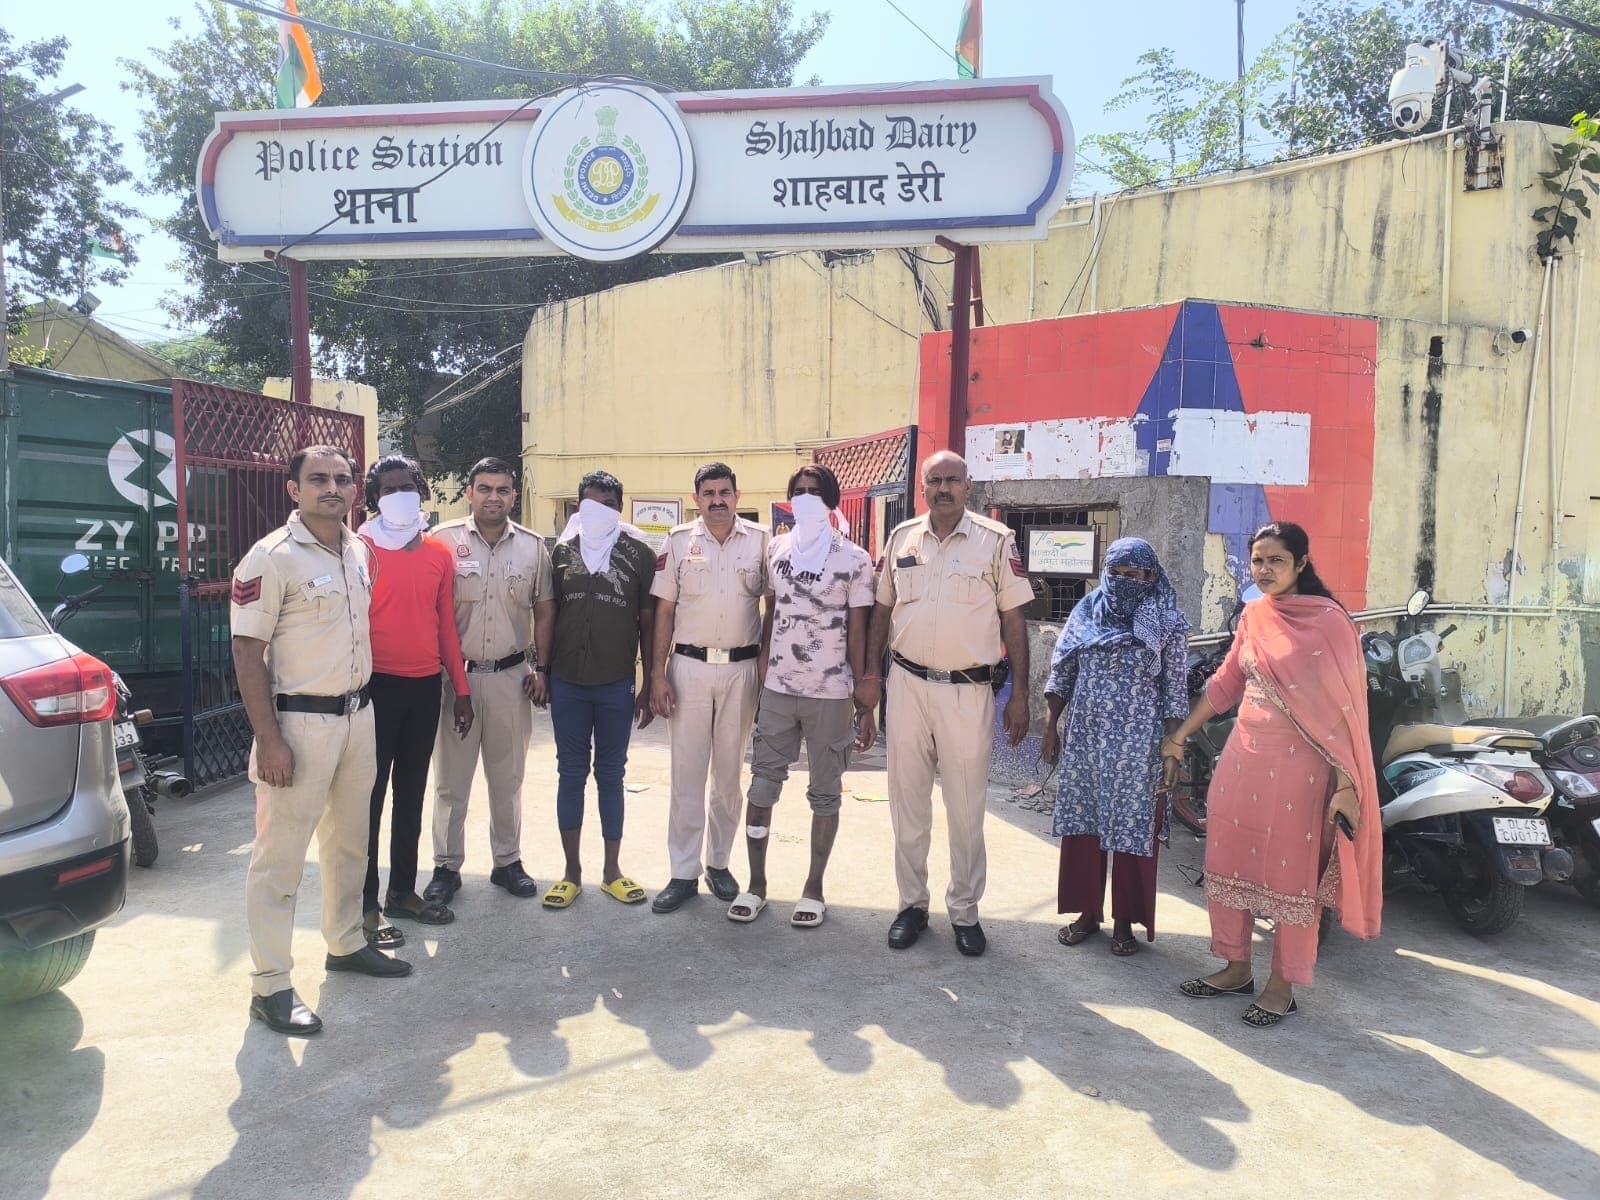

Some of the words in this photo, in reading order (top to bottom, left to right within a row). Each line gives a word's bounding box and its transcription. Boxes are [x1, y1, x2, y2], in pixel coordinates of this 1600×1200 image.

[255, 138, 360, 181] Police
[371, 134, 504, 170] Station
[745, 118, 875, 161] Shahbad
[885, 114, 977, 154] Dairy
[334, 187, 420, 225] थाना
[773, 174, 888, 211] शाहबाद
[896, 160, 945, 203] डेरी
